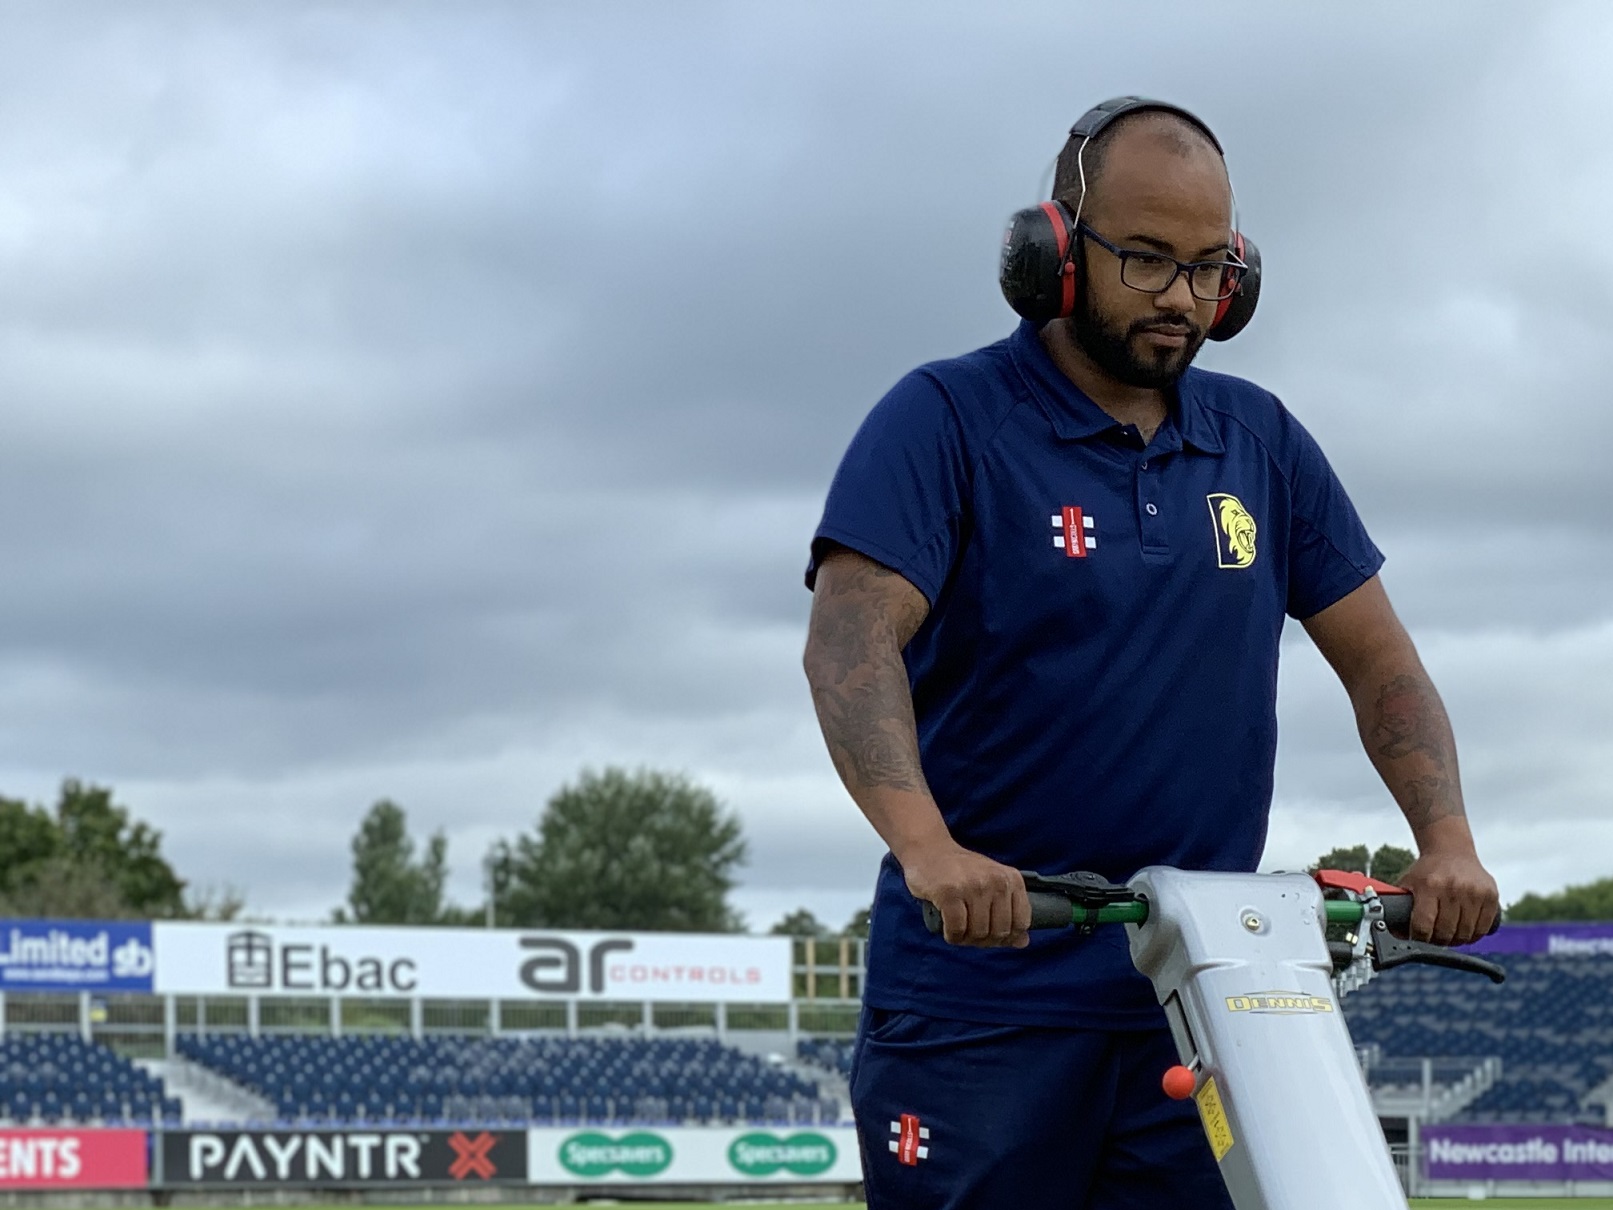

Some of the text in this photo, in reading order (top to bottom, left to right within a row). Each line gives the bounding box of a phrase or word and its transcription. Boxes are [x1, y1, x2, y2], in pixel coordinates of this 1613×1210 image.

[280, 945, 417, 991] Ebac
[519, 937, 761, 993] ar CONTROLS
[0, 1137, 81, 1179] NTS
[190, 1134, 421, 1179] PAYNTR
[566, 1142, 665, 1168] Specsavers
[736, 1142, 830, 1166] Specsavers
[1430, 1137, 1557, 1164] Newcastle
